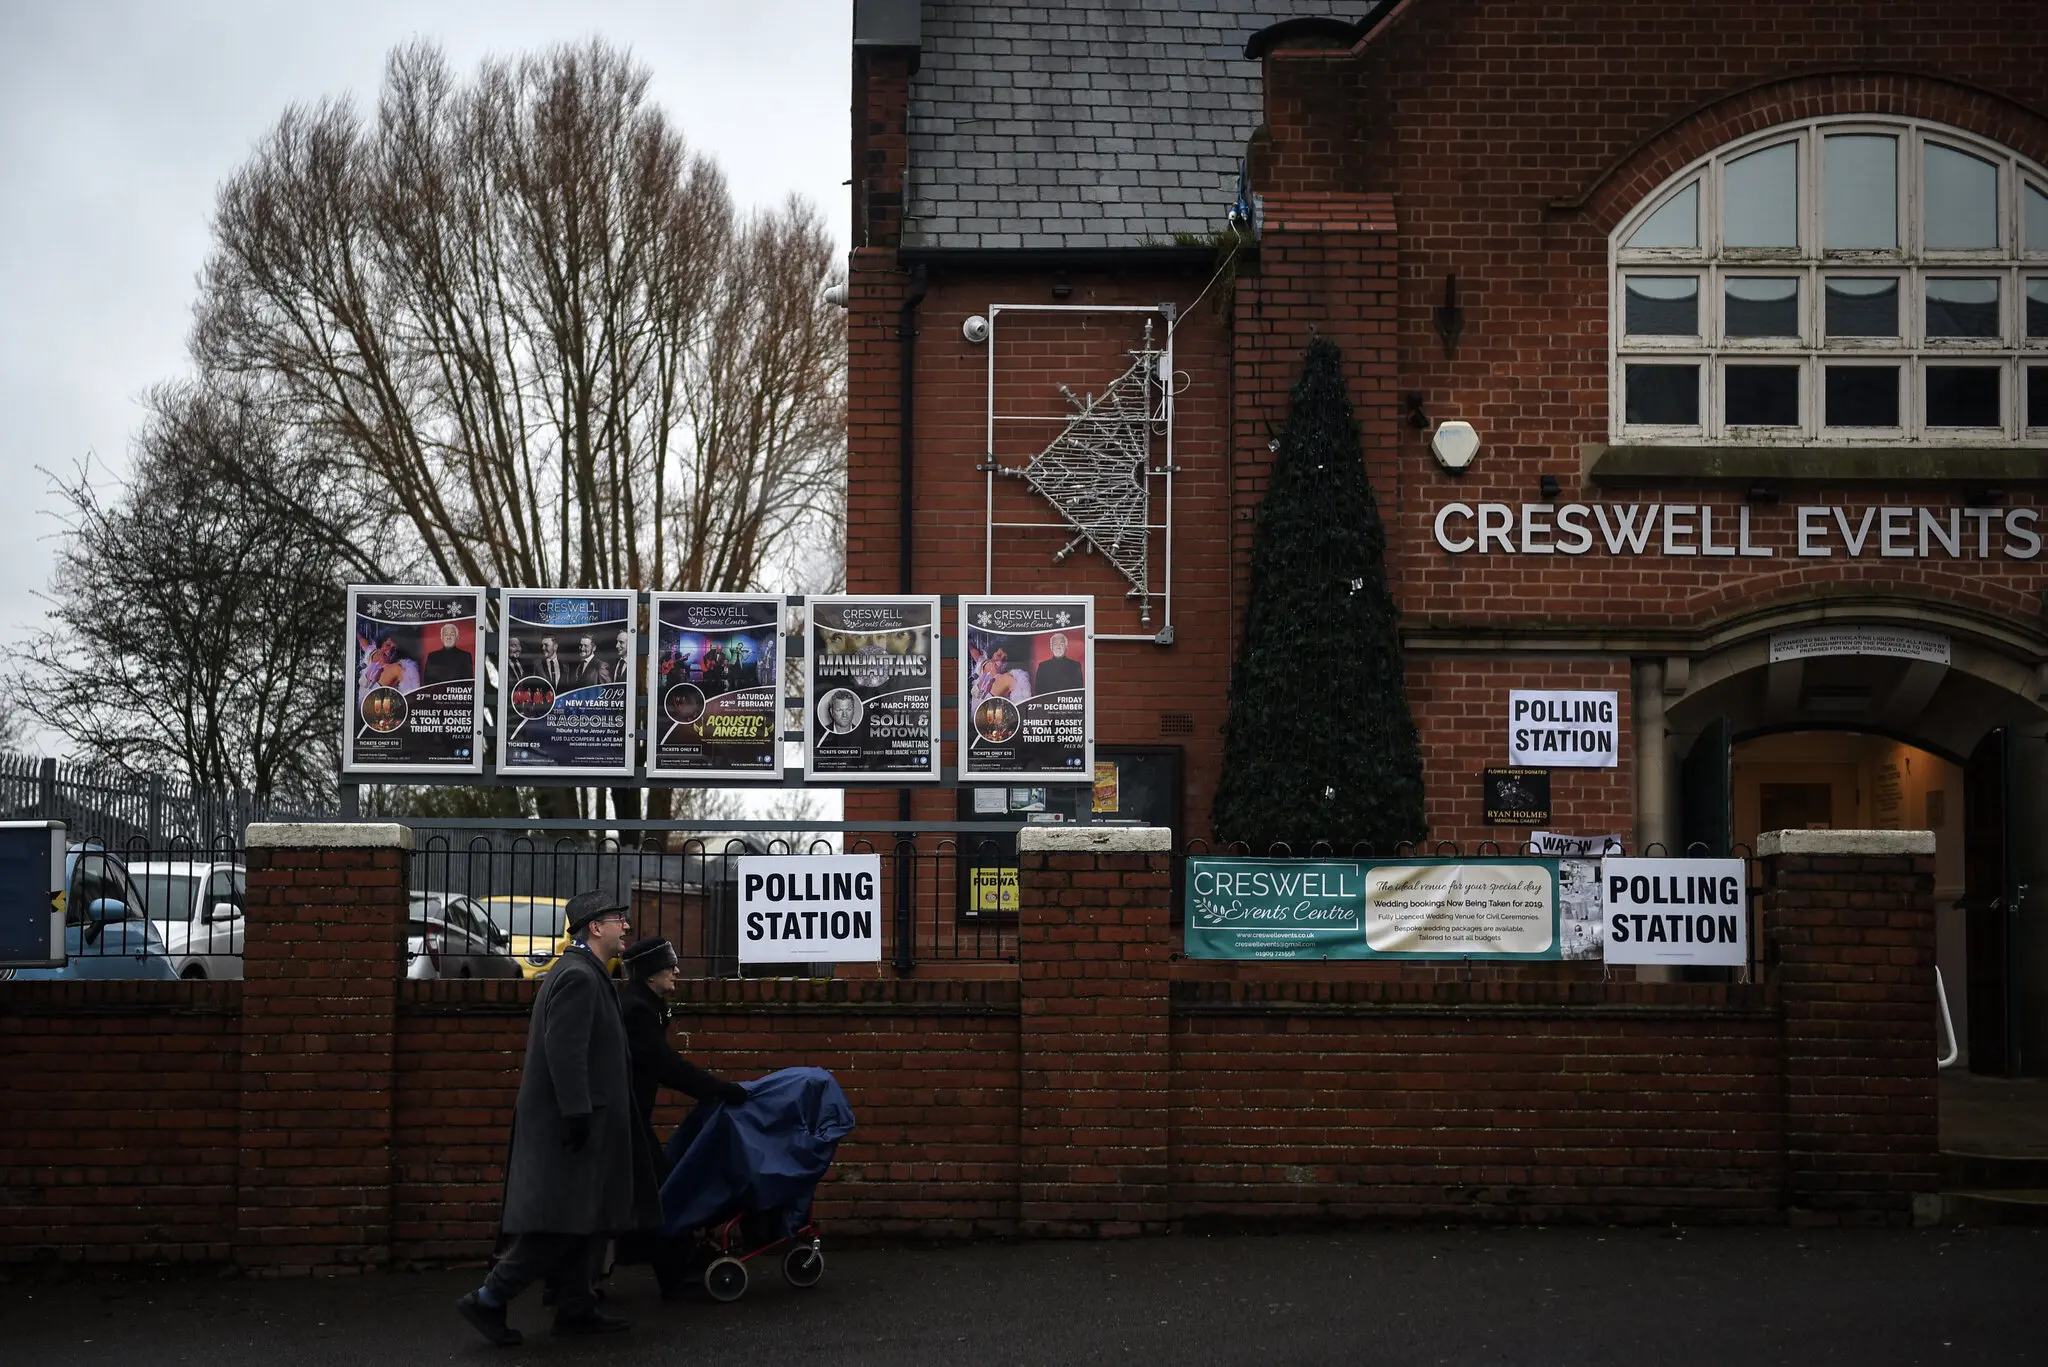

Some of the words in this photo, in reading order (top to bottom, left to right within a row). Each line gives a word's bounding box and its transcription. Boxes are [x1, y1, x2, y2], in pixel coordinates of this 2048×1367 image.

[1434, 502, 1773, 557] CRESWELL
[1799, 506, 2043, 559] EVENTS
[383, 600, 445, 610] CRESWELL
[538, 602, 600, 613] CRESWELL
[397, 610, 421, 618] Events
[421, 610, 445, 618] Centre
[576, 612, 599, 620] Centre
[687, 606, 748, 617] CRESWELL
[842, 609, 903, 619] CRESWELL
[993, 609, 1054, 620] CRESWELL
[698, 616, 725, 626] Events
[725, 616, 748, 625] Centre
[854, 619, 879, 627] Events
[879, 619, 902, 627] Centre
[1006, 620, 1031, 629] Events
[1030, 620, 1053, 628] Centre
[1809, 640, 1852, 648] CONSUMPTION
[818, 654, 927, 676] MANHATTANS
[596, 688, 625, 700] 2019
[736, 693, 774, 701] SATURDAY
[610, 700, 625, 708] EVE
[1044, 703, 1083, 711] DECEMBER
[1514, 699, 1613, 724] POLLING
[410, 717, 418, 725] &
[419, 717, 441, 725] TOM
[442, 717, 472, 725] JONES
[546, 714, 625, 728] RAGDOLLS
[706, 715, 764, 727] ACOUSTIC
[869, 714, 914, 726] SOUL
[918, 714, 929, 726] &
[410, 725, 443, 733] TRIBUTE
[445, 725, 472, 733] SHOW
[712, 726, 758, 738] ANGELS
[869, 727, 929, 738] MOTOWN
[1022, 727, 1030, 735] &
[1031, 727, 1052, 735] TOM
[1054, 727, 1083, 735] JONES
[891, 740, 929, 748] MANHATTANS
[1022, 735, 1055, 743] TRIBUTE
[1057, 735, 1083, 743] SHOW
[1515, 728, 1612, 752] STATION
[1487, 810, 1511, 818] RYAN
[1513, 810, 1548, 819] HOLMES
[1543, 836, 1573, 852] WAY
[1578, 839, 1592, 852] IN
[745, 871, 874, 902] POLLING
[974, 877, 1020, 886] PUBWA
[1194, 871, 1357, 898] CRESWELL
[1375, 880, 1394, 892] The
[1395, 880, 1418, 892] ideal
[1420, 883, 1447, 891] venue
[1448, 880, 1463, 895] for
[1464, 883, 1487, 895] your
[1489, 880, 1522, 895] special
[1523, 880, 1543, 896] day
[1609, 875, 1739, 905] POLLING
[1374, 900, 1409, 909] Wedding
[1410, 899, 1445, 909] bookings
[1465, 899, 1488, 909] Being
[1488, 900, 1511, 908] Taken
[1512, 900, 1523, 908] for
[1525, 901, 1544, 909] 2019.
[1224, 900, 1290, 921] Events
[1293, 900, 1355, 921] Centre
[1378, 913, 1394, 921] Fully
[1425, 913, 1454, 921] Wedding
[746, 910, 872, 941] STATION
[1394, 925, 1422, 933] Bespoke
[1423, 925, 1451, 933] wedding
[1451, 925, 1483, 933] packages
[1611, 913, 1738, 944] STATION
[1236, 932, 1315, 940] www.creswellevents.co.uk
[1234, 941, 1316, 949] creswellevents@gmail.com
